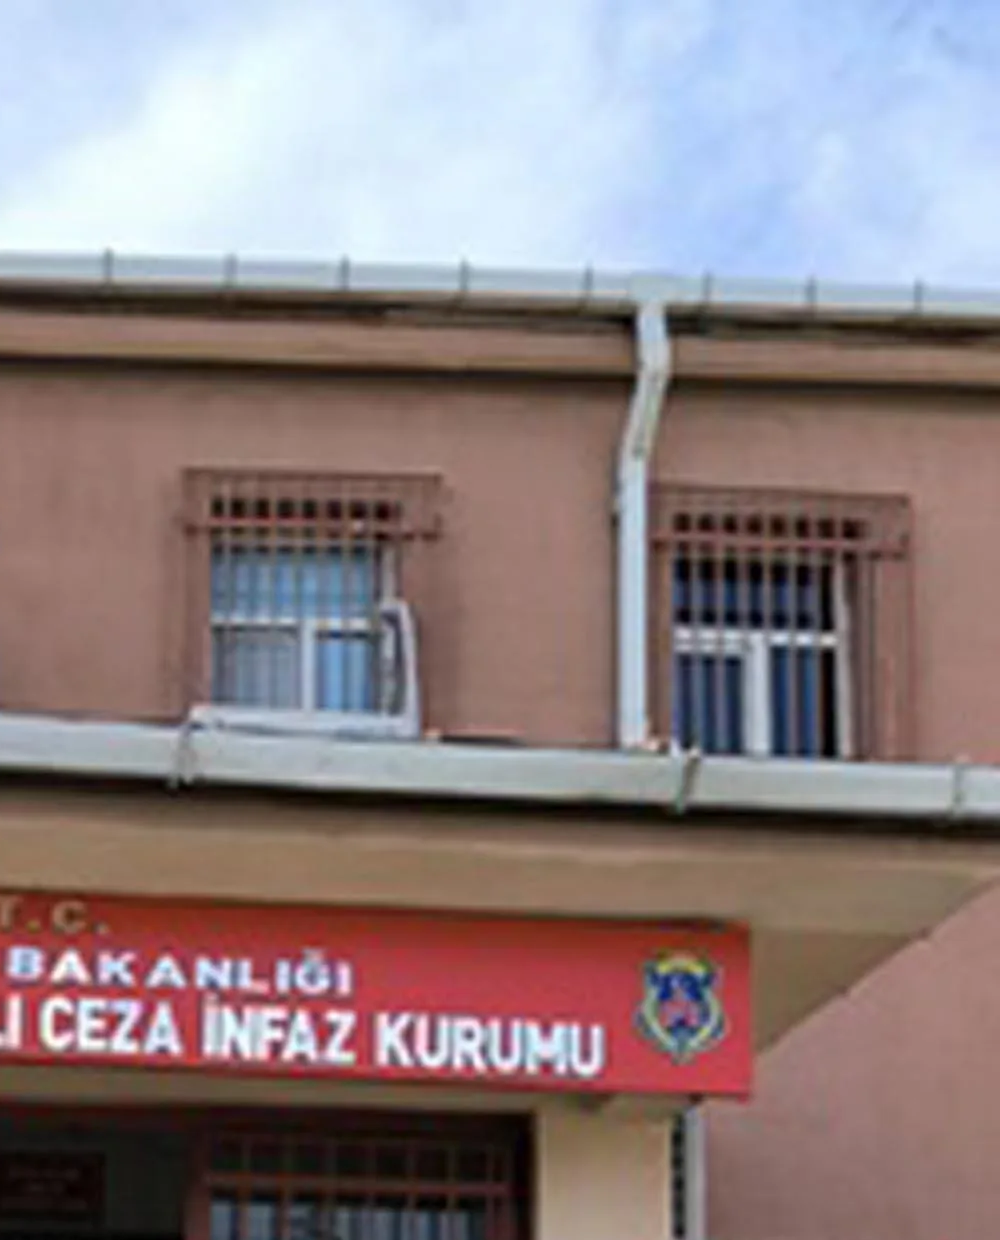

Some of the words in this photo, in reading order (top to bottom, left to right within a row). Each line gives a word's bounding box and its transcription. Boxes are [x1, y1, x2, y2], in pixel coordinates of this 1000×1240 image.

[6, 945, 353, 997] BAKANLIĞI
[40, 995, 183, 1057] CEZA
[203, 996, 356, 1066] İNFAZ
[376, 1011, 605, 1077] KURUMU
